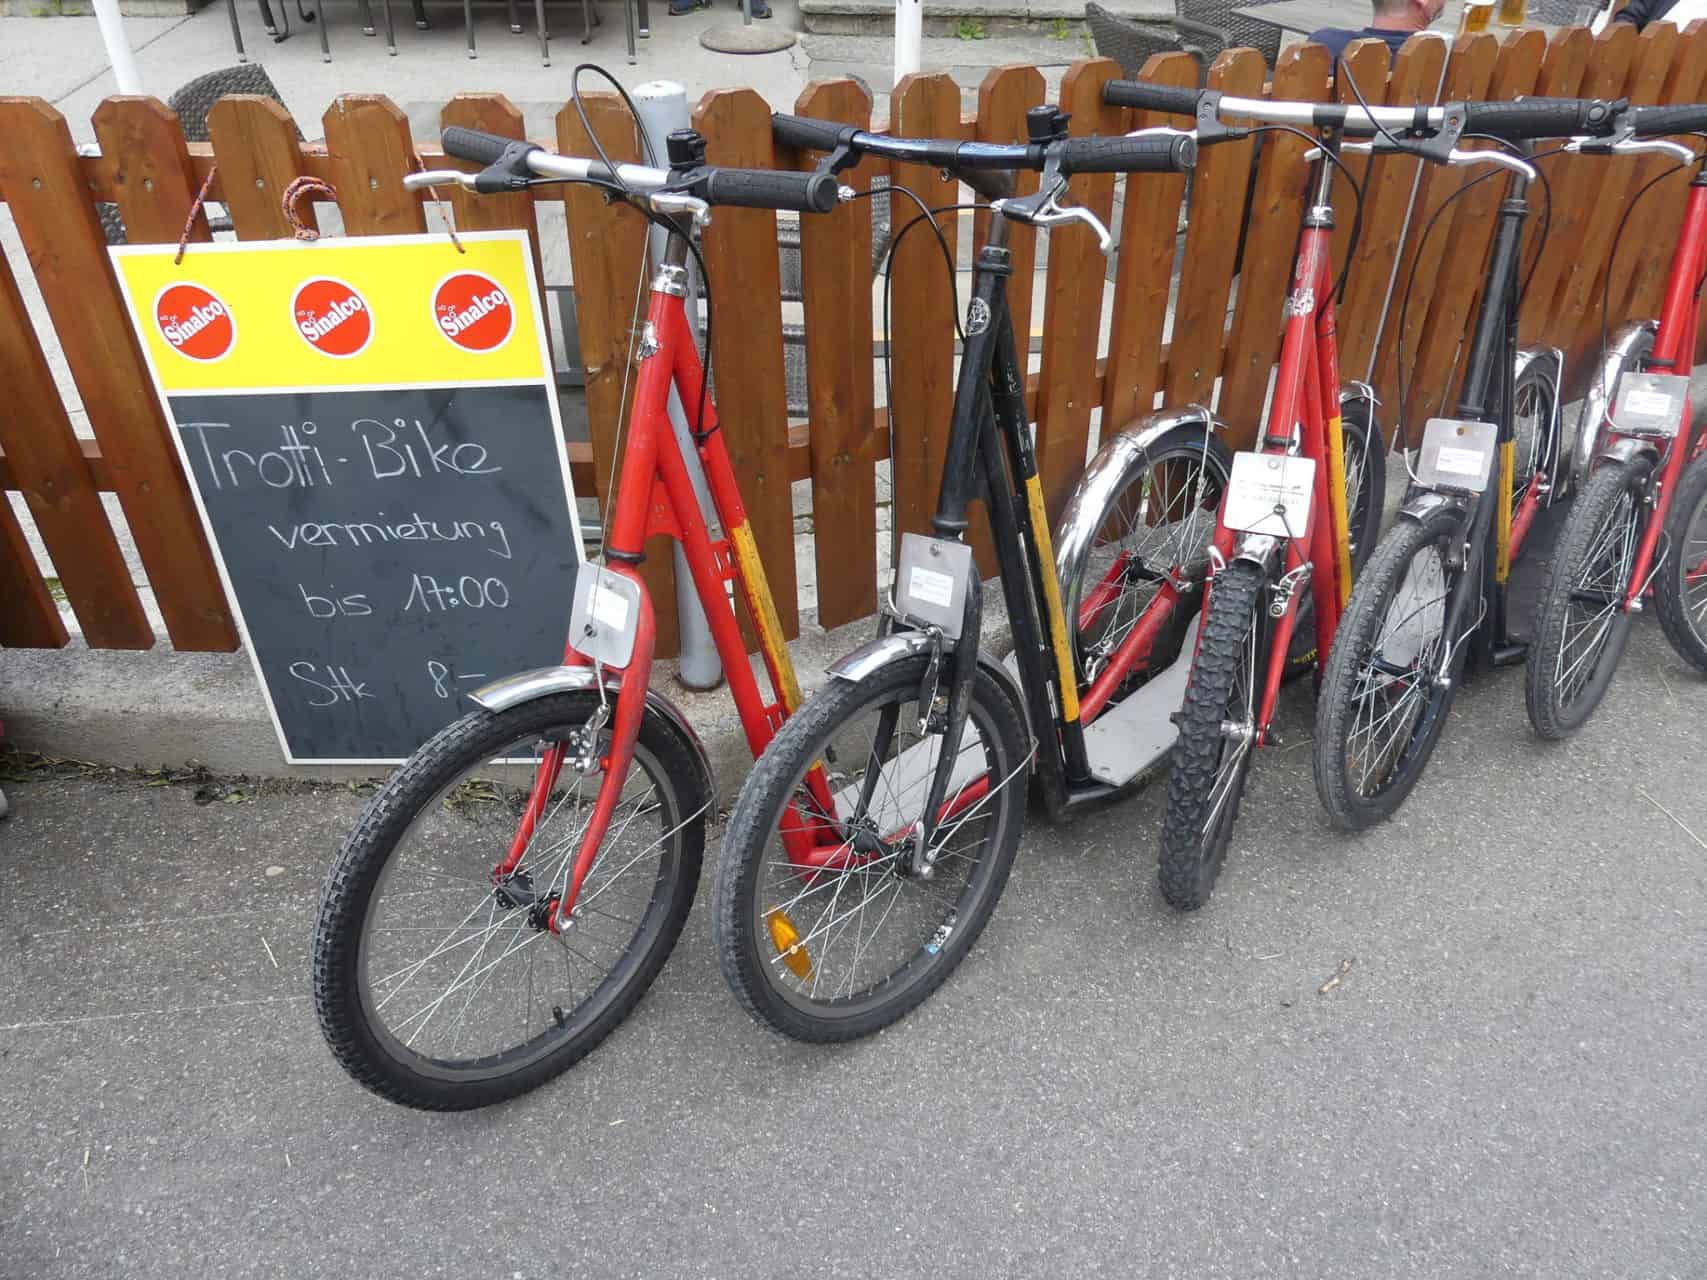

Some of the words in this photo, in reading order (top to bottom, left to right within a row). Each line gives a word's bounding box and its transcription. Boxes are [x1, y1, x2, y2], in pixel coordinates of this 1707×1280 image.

[163, 301, 223, 346] Sinalco
[300, 295, 362, 342] Sinalco
[440, 289, 505, 337] Sinalco
[268, 512, 512, 559] vermietung
[298, 583, 372, 618] bis
[404, 573, 510, 613] 17:00
[289, 660, 377, 706] Stk
